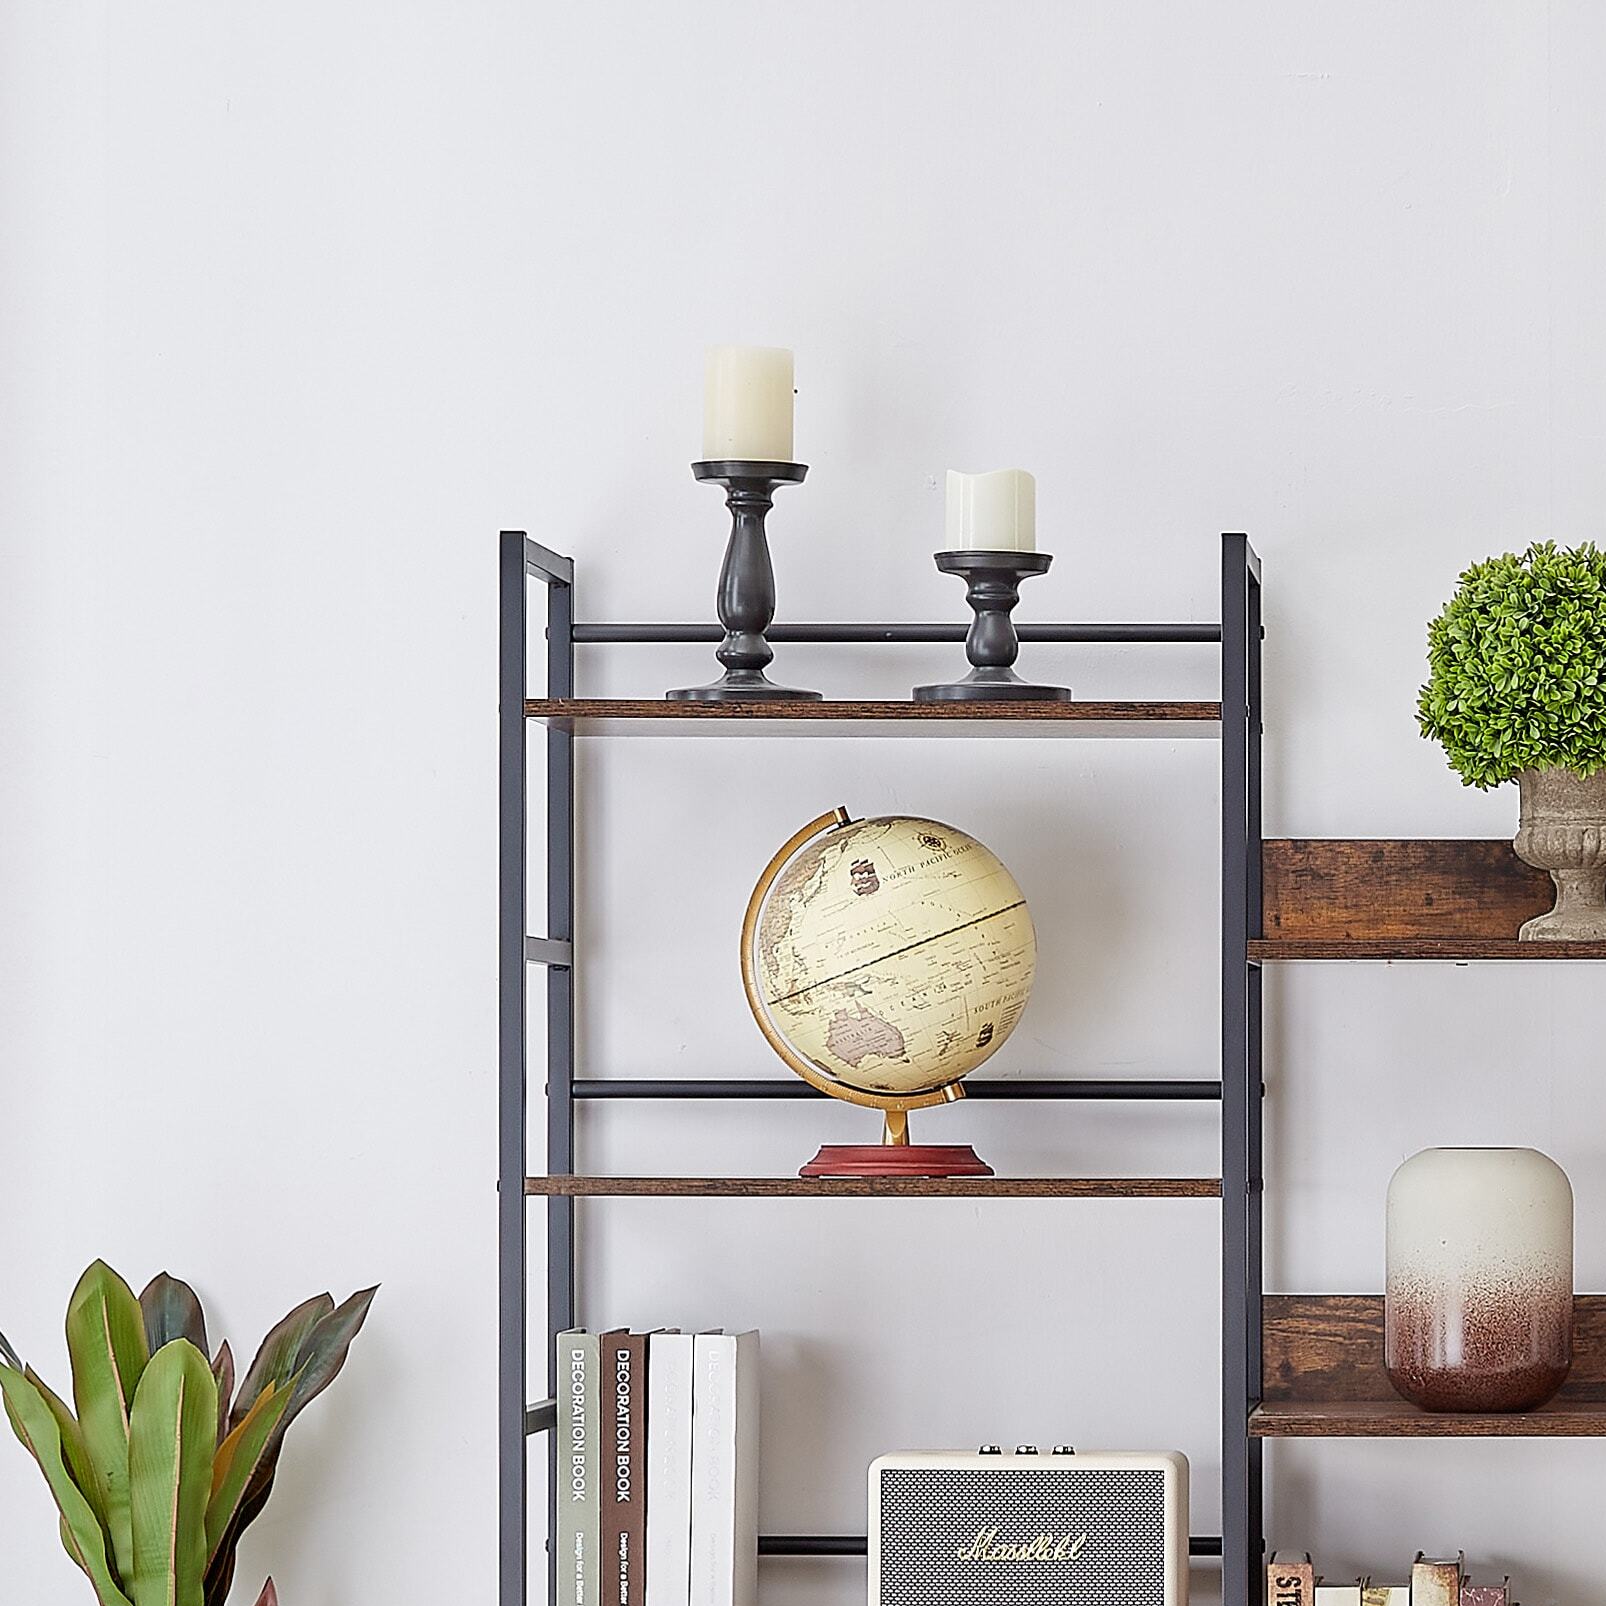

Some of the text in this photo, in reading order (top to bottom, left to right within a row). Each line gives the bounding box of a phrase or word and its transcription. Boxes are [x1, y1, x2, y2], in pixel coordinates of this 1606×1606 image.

[882, 866, 915, 884] NORTH
[920, 852, 954, 869] PACIFIC
[973, 999, 1001, 1015] SOUTH
[571, 1349, 586, 1502] DECORATION BOOK
[616, 1349, 630, 1502] DECORATION BOOK
[574, 1532, 585, 1560] Design
[618, 1532, 629, 1560] Design
[576, 1560, 585, 1573] for
[620, 1560, 630, 1573] for
[575, 1580, 584, 1604] Better
[620, 1580, 629, 1605] Better
